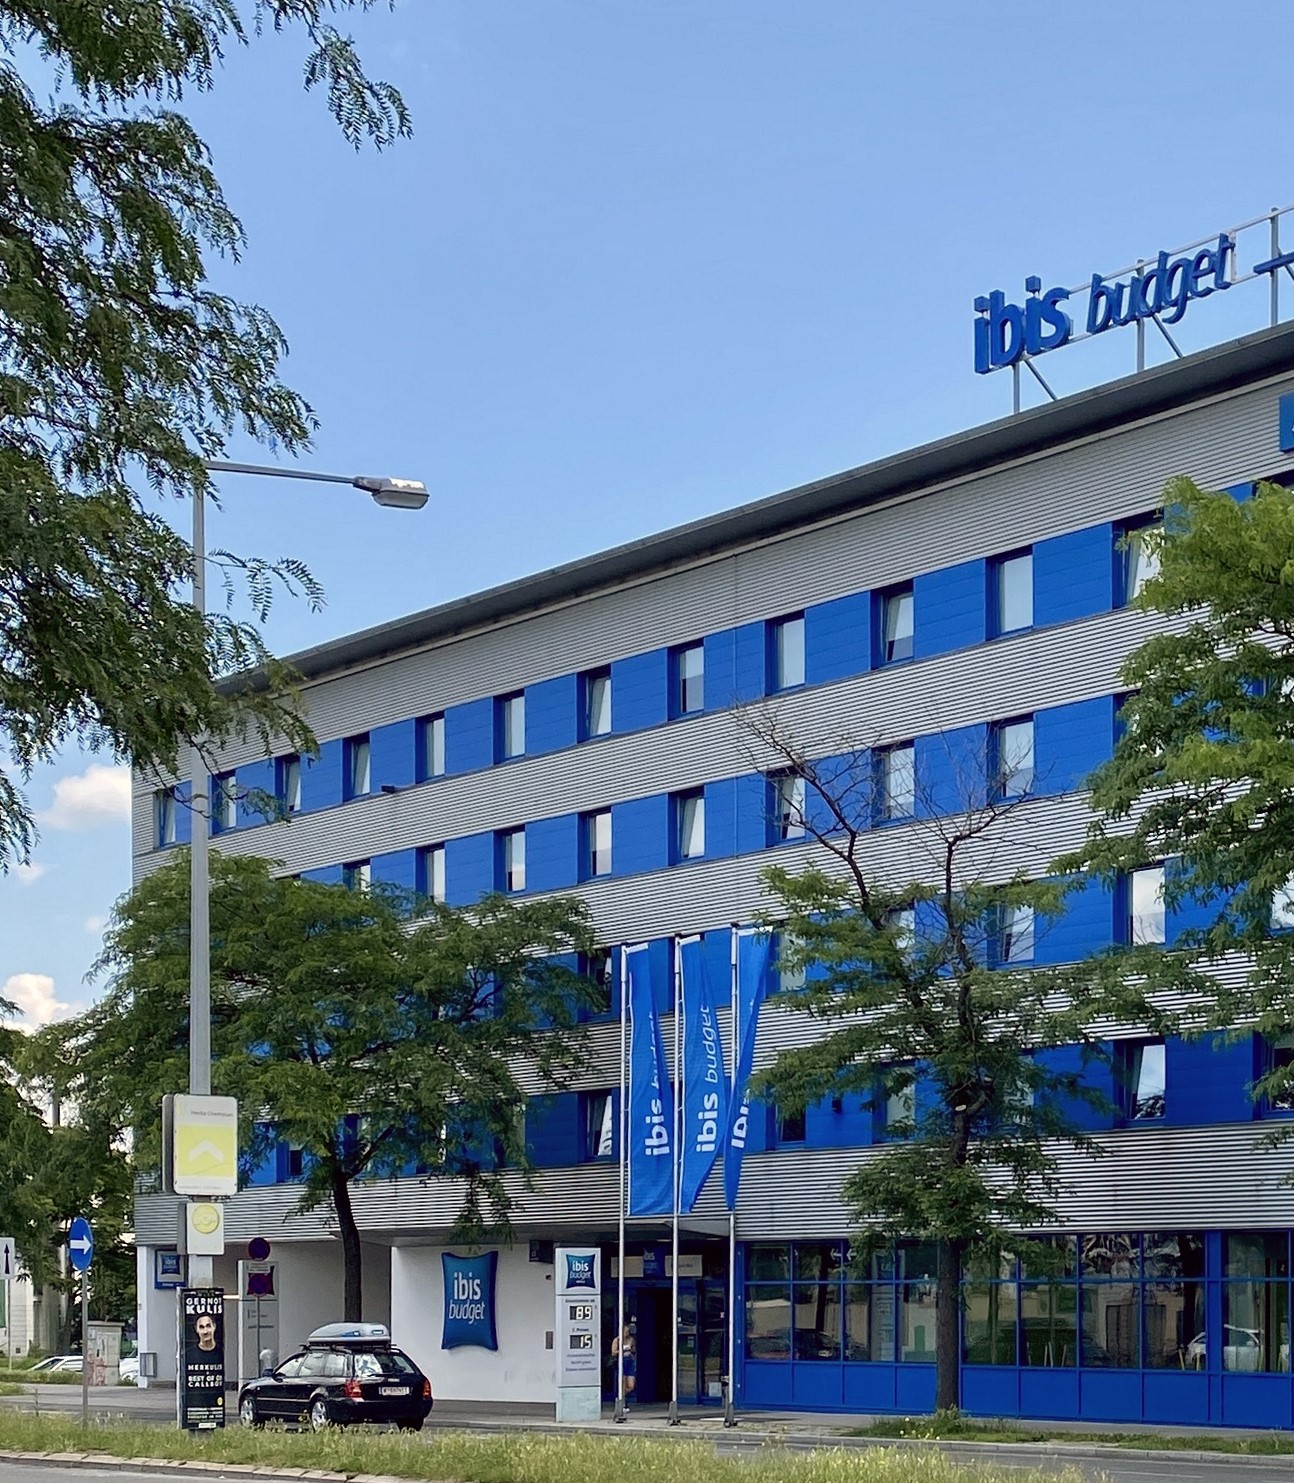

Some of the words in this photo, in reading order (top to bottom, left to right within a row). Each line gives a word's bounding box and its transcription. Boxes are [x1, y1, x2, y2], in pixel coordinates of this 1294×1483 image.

[974, 275, 1071, 374] ibis
[1087, 233, 1235, 324] budget
[700, 1004, 719, 1084] budget
[644, 1098, 671, 1156] ibis
[696, 1092, 719, 1152] ibis
[572, 1260, 589, 1271] ibis
[453, 1271, 481, 1300] ibis
[569, 1271, 592, 1281] budget
[186, 1297, 222, 1305] GERNOT
[186, 1305, 222, 1315] KULIS
[448, 1299, 485, 1325] budget
[575, 1306, 592, 1320] 89
[580, 1335, 592, 1349] 15
